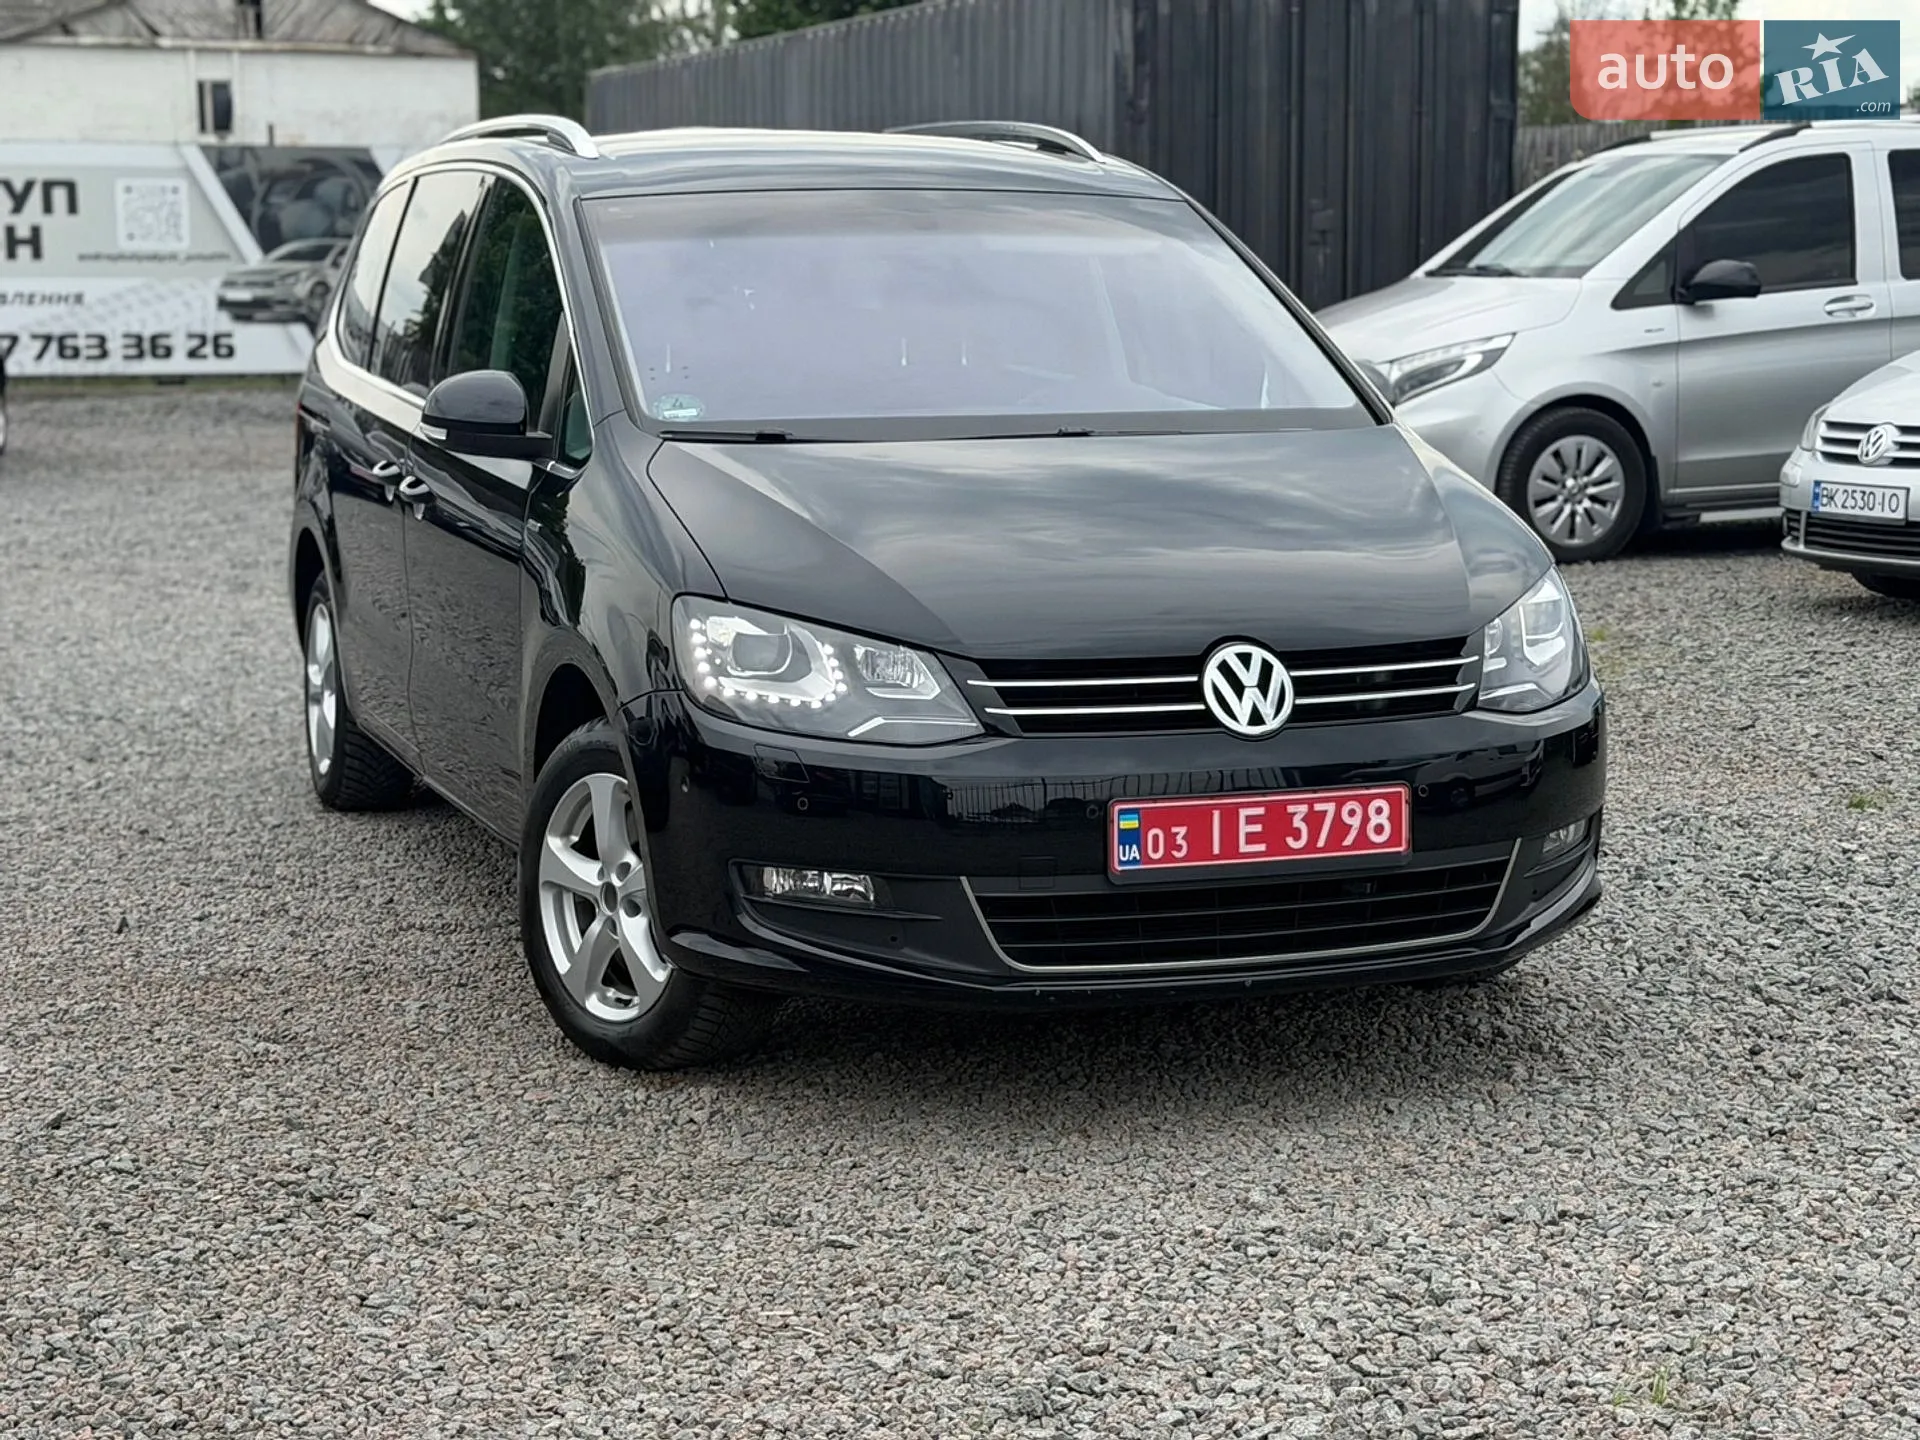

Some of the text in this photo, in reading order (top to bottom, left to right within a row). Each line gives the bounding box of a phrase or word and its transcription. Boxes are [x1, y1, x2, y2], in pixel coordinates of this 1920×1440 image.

[31, 334, 109, 361] 763
[122, 334, 173, 359] 36
[187, 333, 234, 359] 26
[1147, 825, 1188, 859] 03
[1285, 799, 1391, 850] 3798
[1119, 844, 1140, 861] UA
